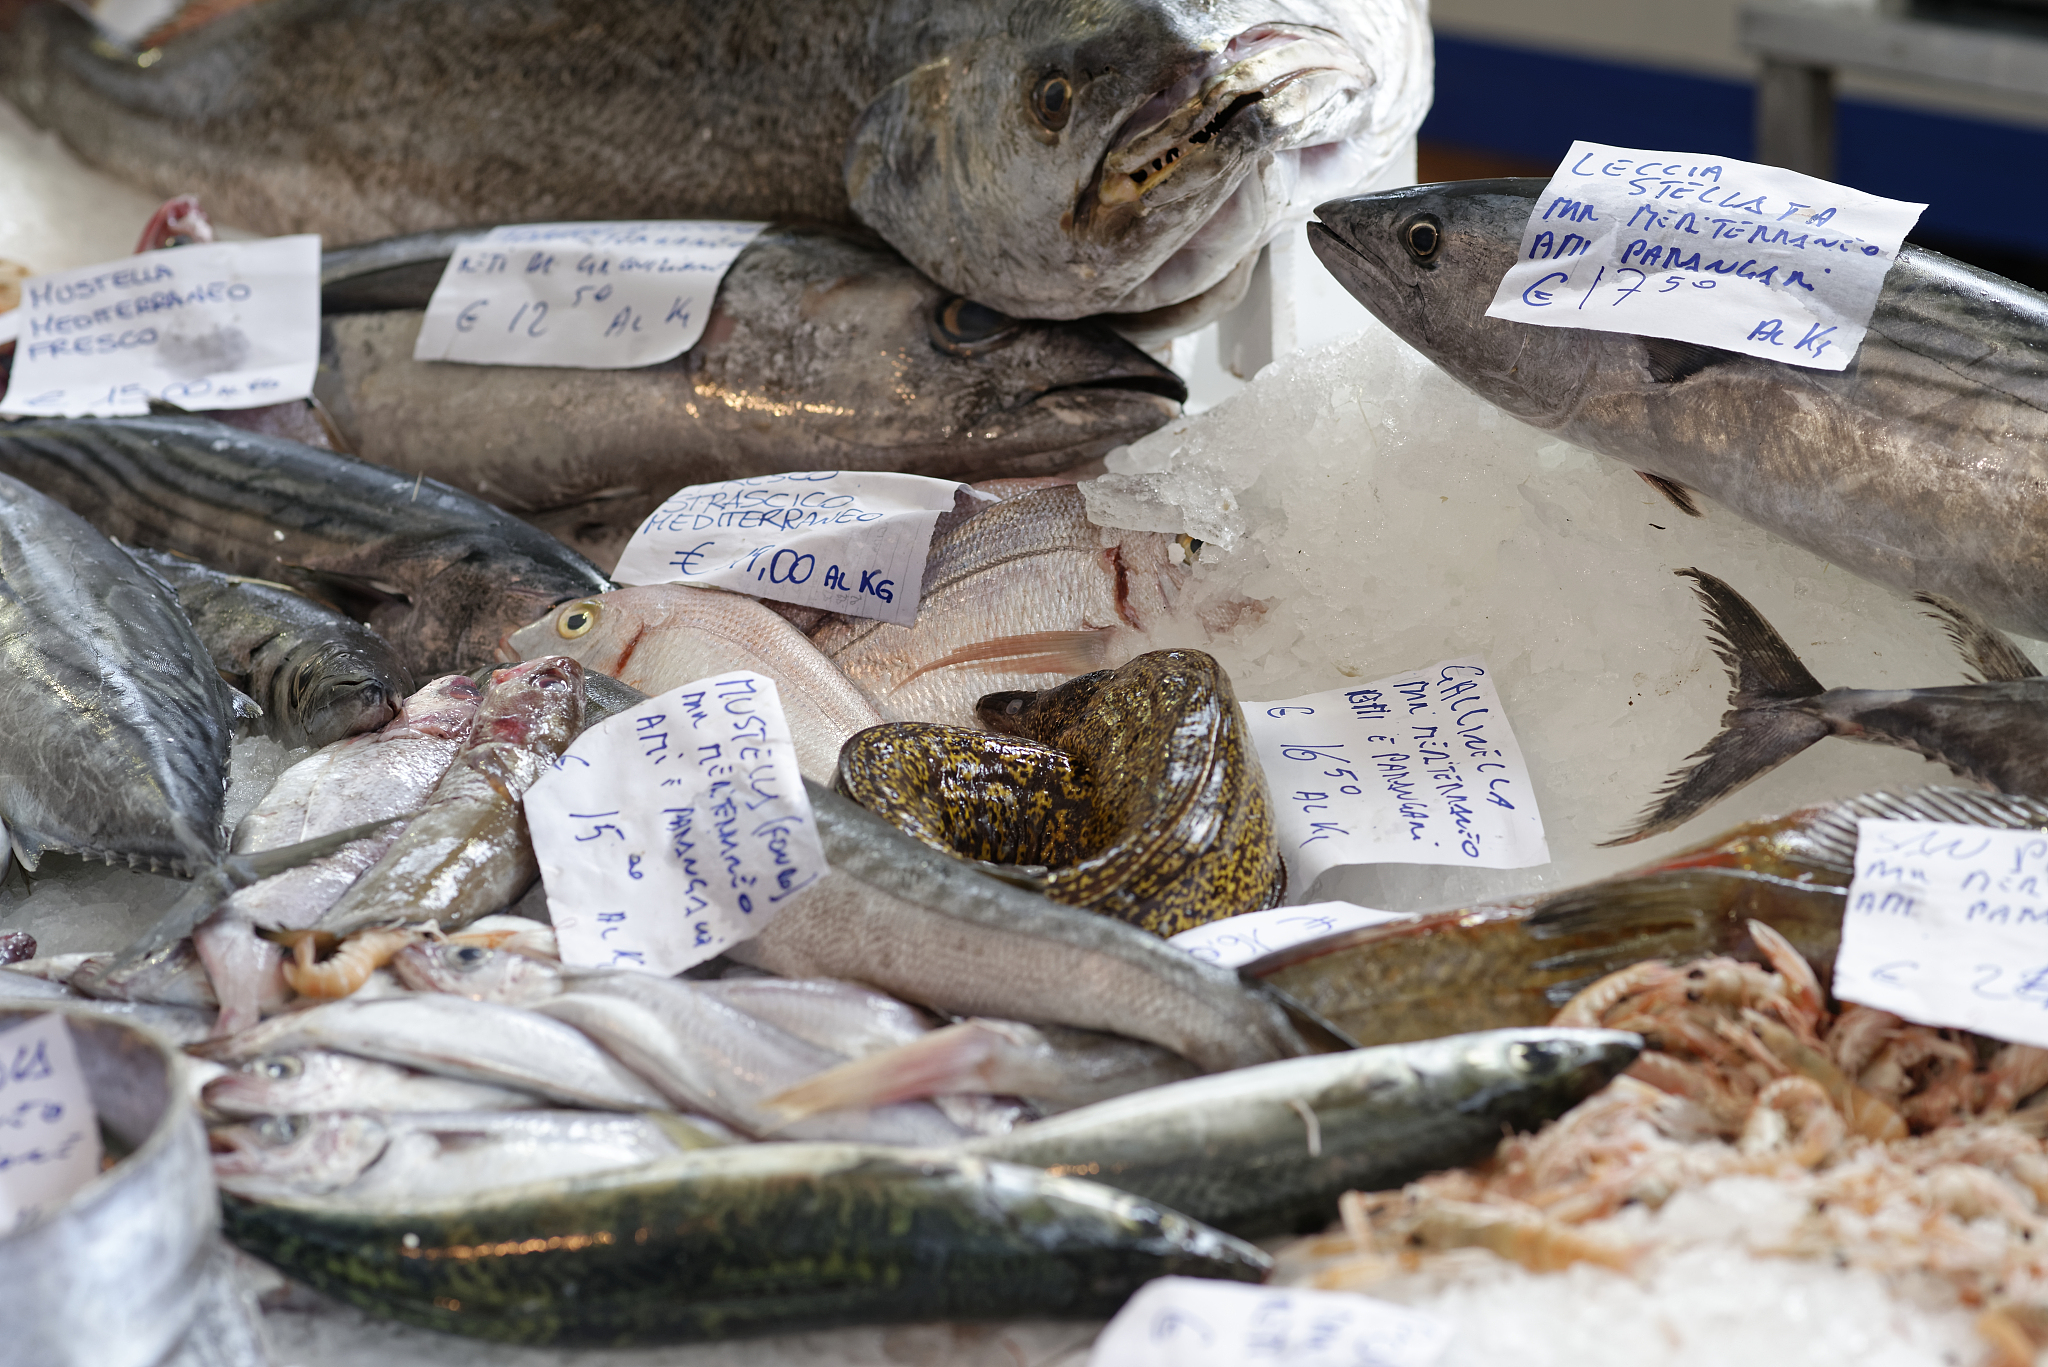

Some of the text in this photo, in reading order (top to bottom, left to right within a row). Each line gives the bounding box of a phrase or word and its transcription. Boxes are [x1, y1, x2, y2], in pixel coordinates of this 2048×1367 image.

[1571, 152, 1723, 182] LECCIA
[1522, 272, 1567, 307] €
[28, 327, 159, 361] FRESCO
[661, 489, 854, 513] STRASCICO
[643, 508, 884, 534] MEDITERRANEO
[669, 541, 715, 577] €
[824, 565, 850, 591] AL
[859, 569, 895, 603] KG
